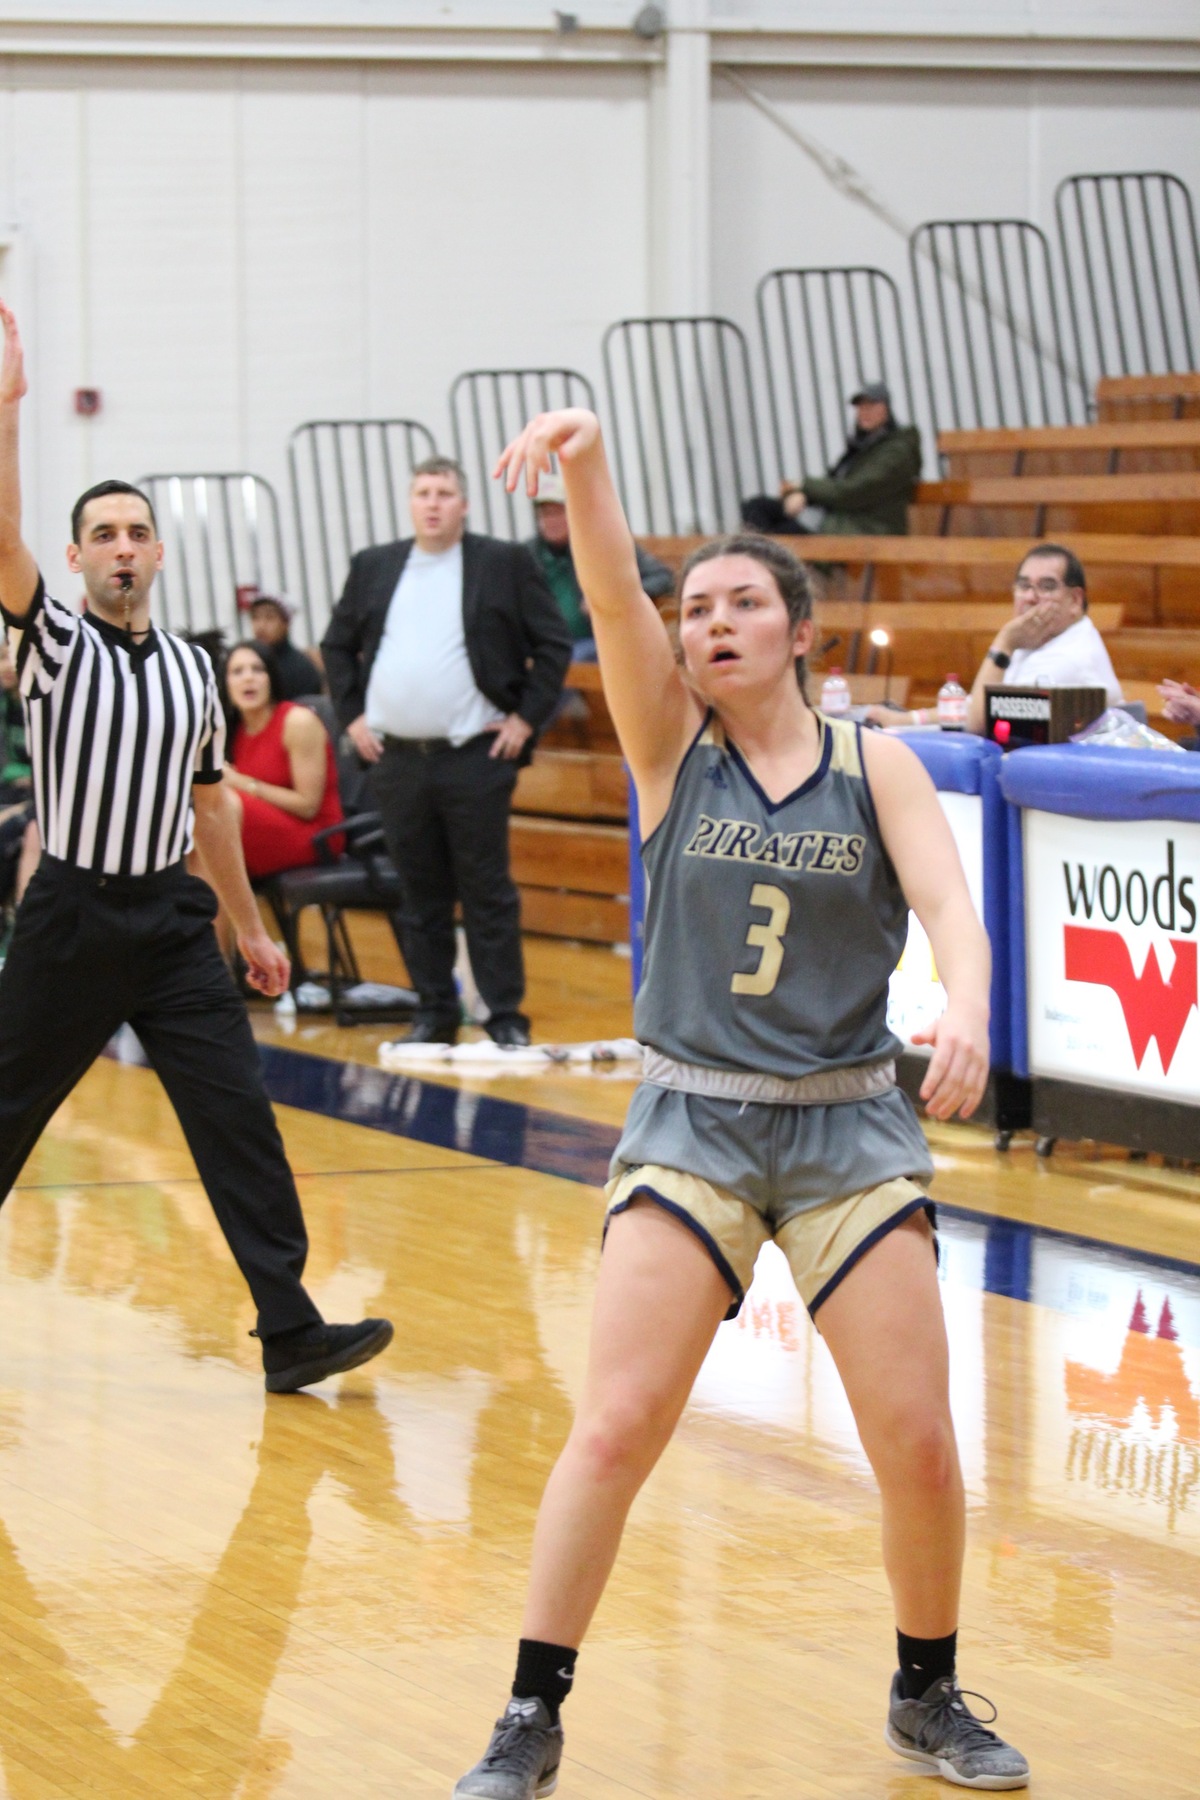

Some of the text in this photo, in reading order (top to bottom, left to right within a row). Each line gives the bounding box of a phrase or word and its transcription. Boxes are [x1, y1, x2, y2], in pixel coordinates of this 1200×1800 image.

[683, 814, 867, 876] PIRATES
[1062, 838, 1197, 934] woods
[730, 882, 791, 997] 3
